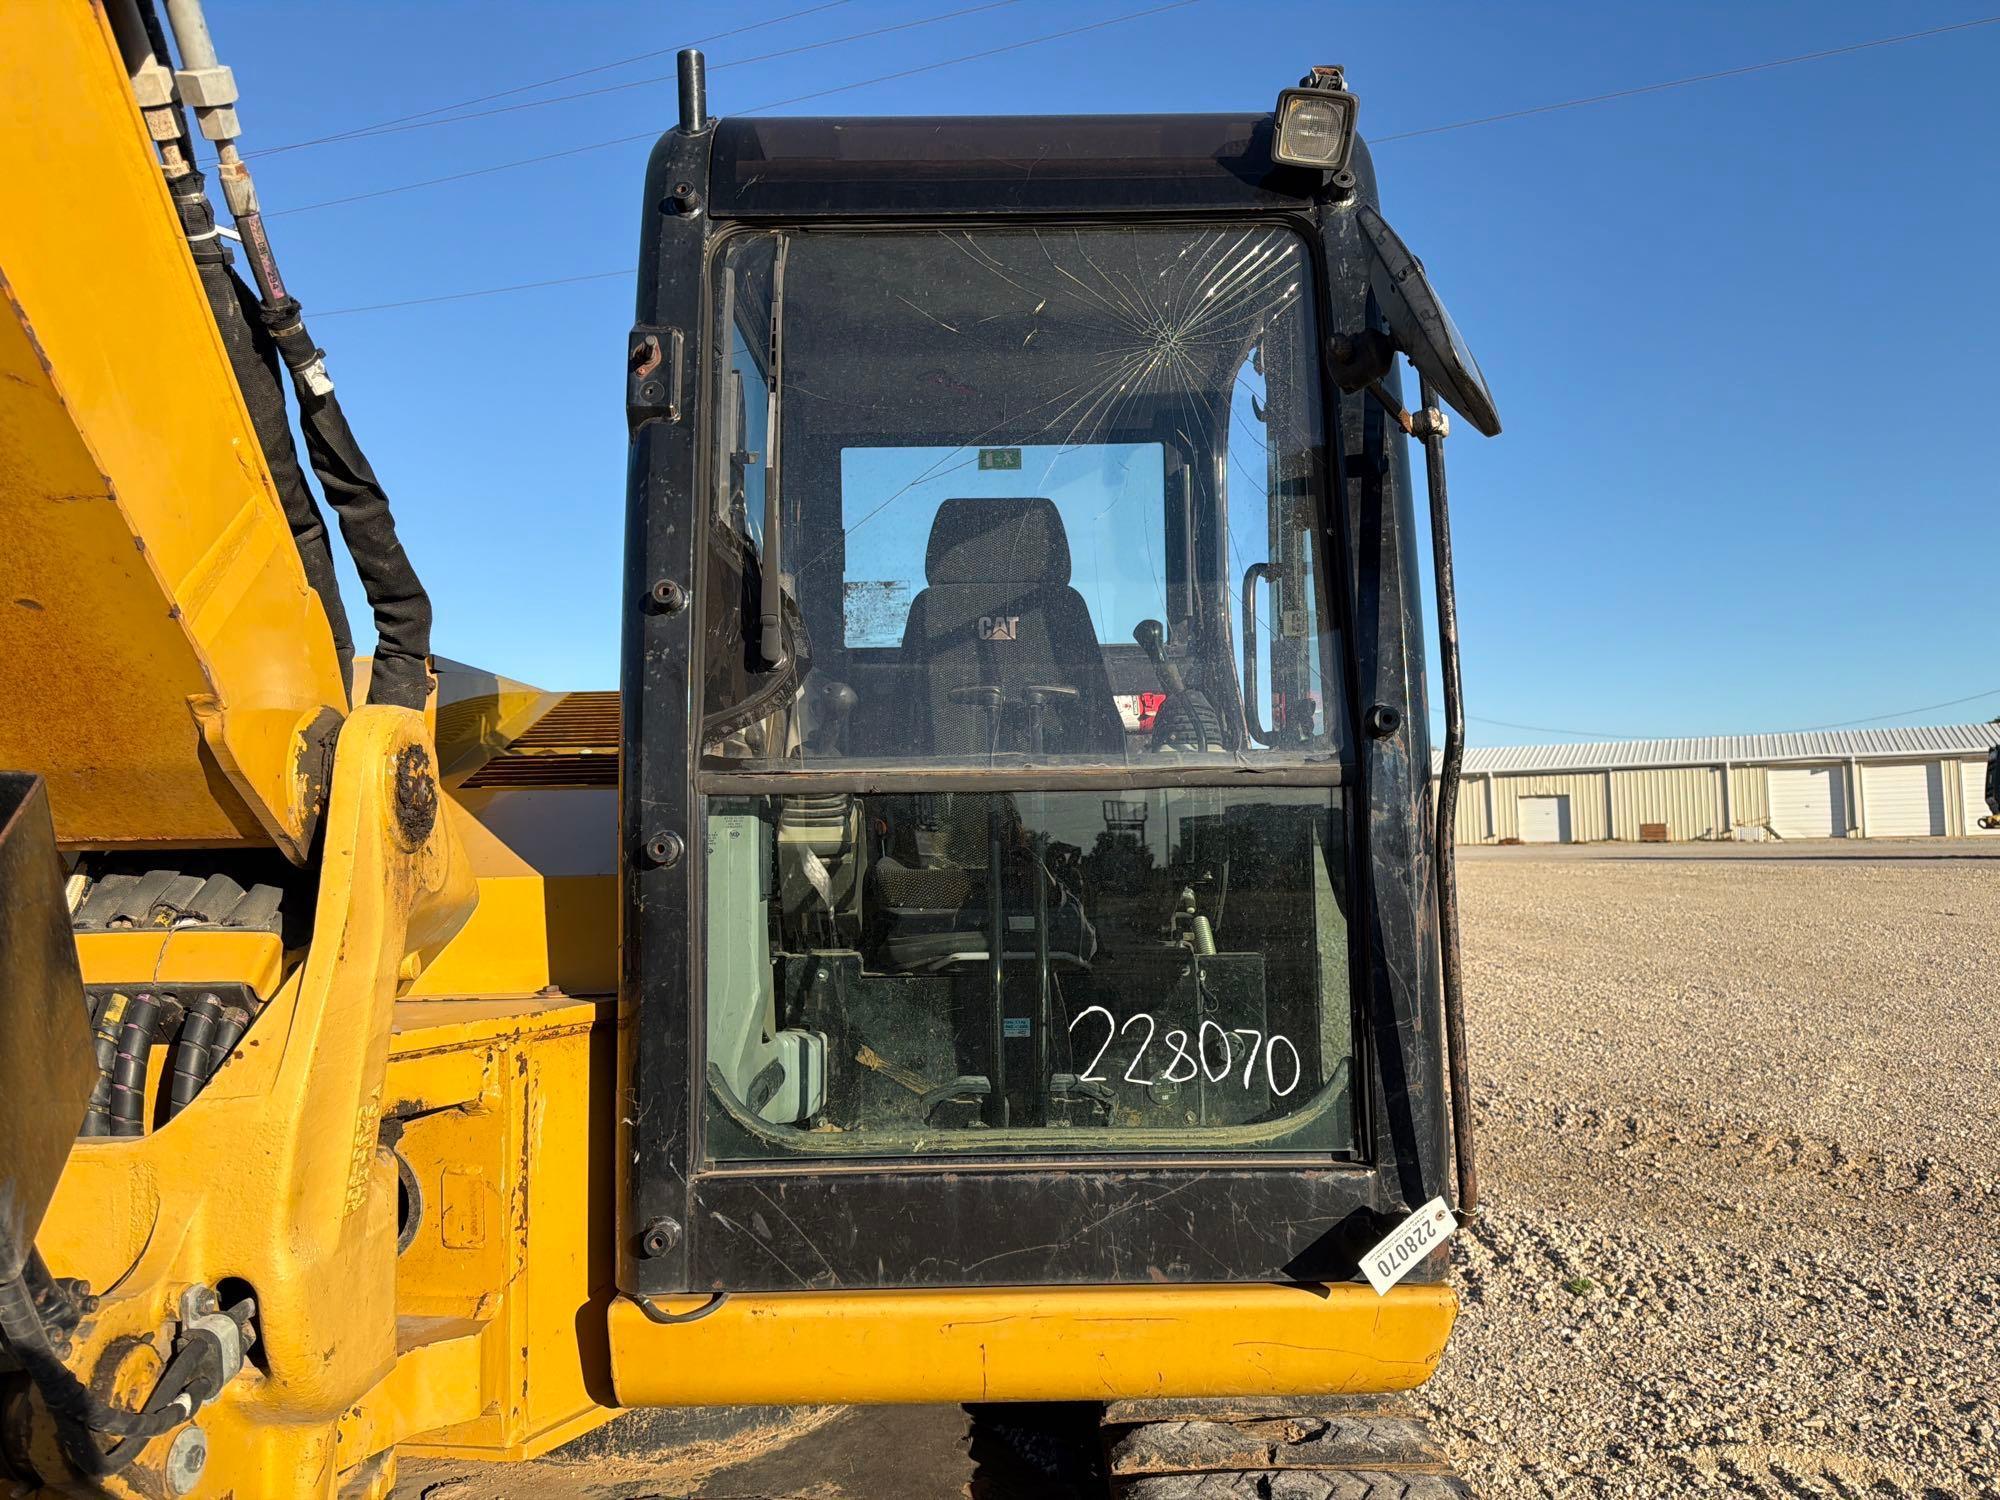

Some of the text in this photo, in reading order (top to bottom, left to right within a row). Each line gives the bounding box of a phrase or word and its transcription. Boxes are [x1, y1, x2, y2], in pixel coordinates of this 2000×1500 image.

[979, 616, 1019, 640] CAT
[1069, 1006, 1300, 1096] 228070
[1378, 1219, 1437, 1278] 228070
